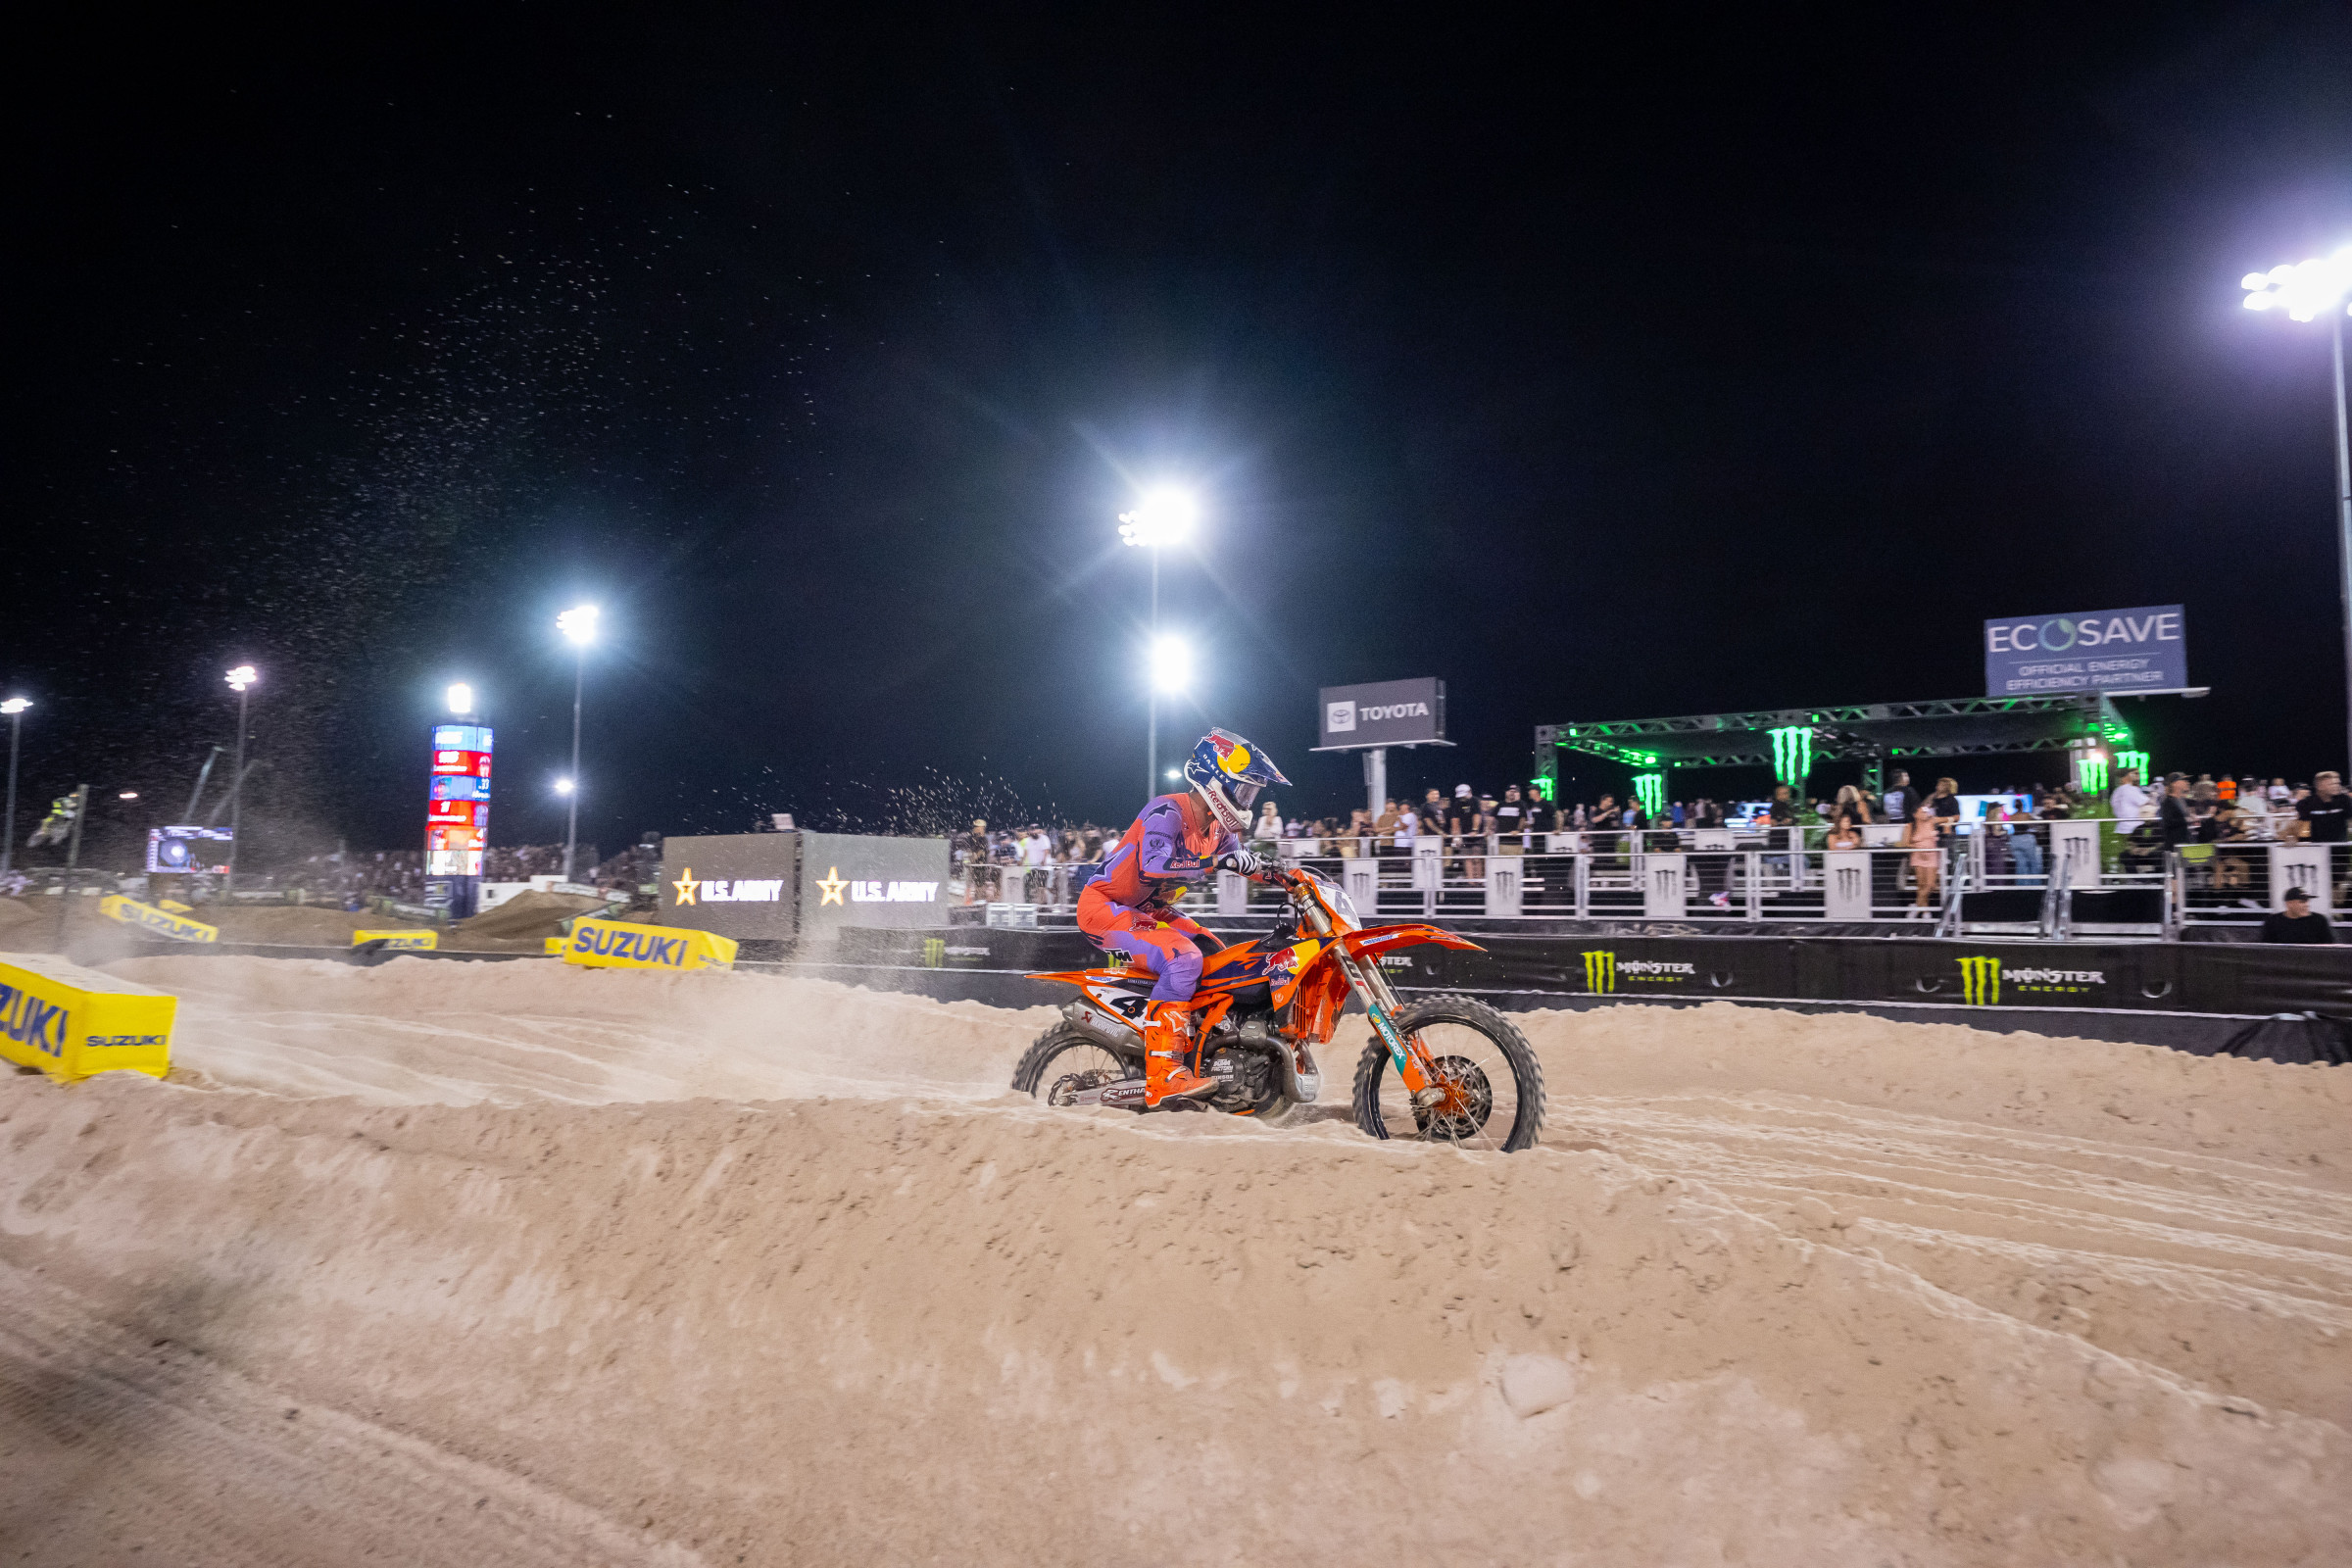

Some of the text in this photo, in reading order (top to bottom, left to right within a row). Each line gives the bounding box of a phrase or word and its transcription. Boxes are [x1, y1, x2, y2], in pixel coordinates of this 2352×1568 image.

[1987, 612, 2180, 654] ECOSAVE
[2019, 659, 2150, 676] OFFICIAL ENERGY
[2006, 671, 2164, 690] EFFICIENCY PARTNER
[1359, 702, 1429, 721] TOYOTA
[1202, 754, 1231, 783] OAKLEY
[701, 880, 783, 902] U.S. ARMY
[851, 881, 939, 902] U.S. ARMY
[1335, 891, 1360, 923] 4
[119, 903, 210, 942] SUZUKI
[574, 926, 688, 966] SUZUKI
[1616, 960, 1695, 974] MONSTER
[2002, 967, 2106, 984] MONSTER
[1109, 996, 1149, 1019] 4
[0, 983, 69, 1057] ZUKI
[86, 1035, 167, 1047] SUZUKI
[1378, 1022, 1405, 1059] MOTOREX
[1102, 1088, 1146, 1101] RENTHA
